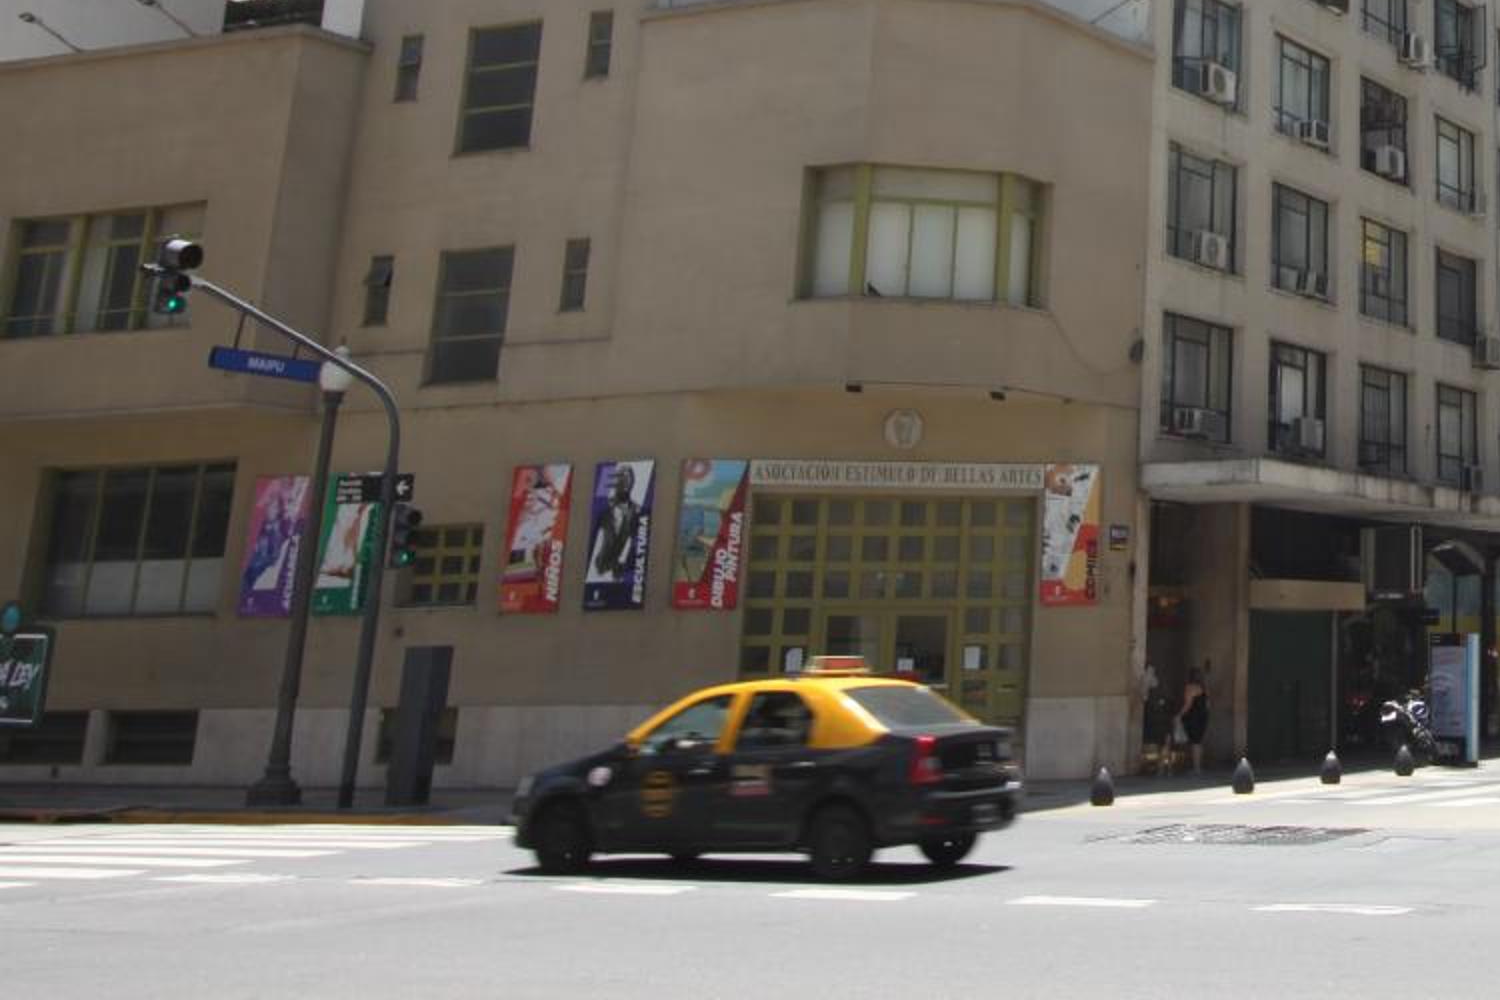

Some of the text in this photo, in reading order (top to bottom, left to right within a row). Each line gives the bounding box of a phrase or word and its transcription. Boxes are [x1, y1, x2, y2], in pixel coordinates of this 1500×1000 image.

[944, 467, 995, 483] BELLAS
[1000, 468, 1041, 483] ARTES
[545, 540, 564, 602] NIÑOS
[631, 515, 650, 603] ESCULTURA
[724, 511, 744, 582] PINTURA
[710, 548, 727, 608] DIBUJO
